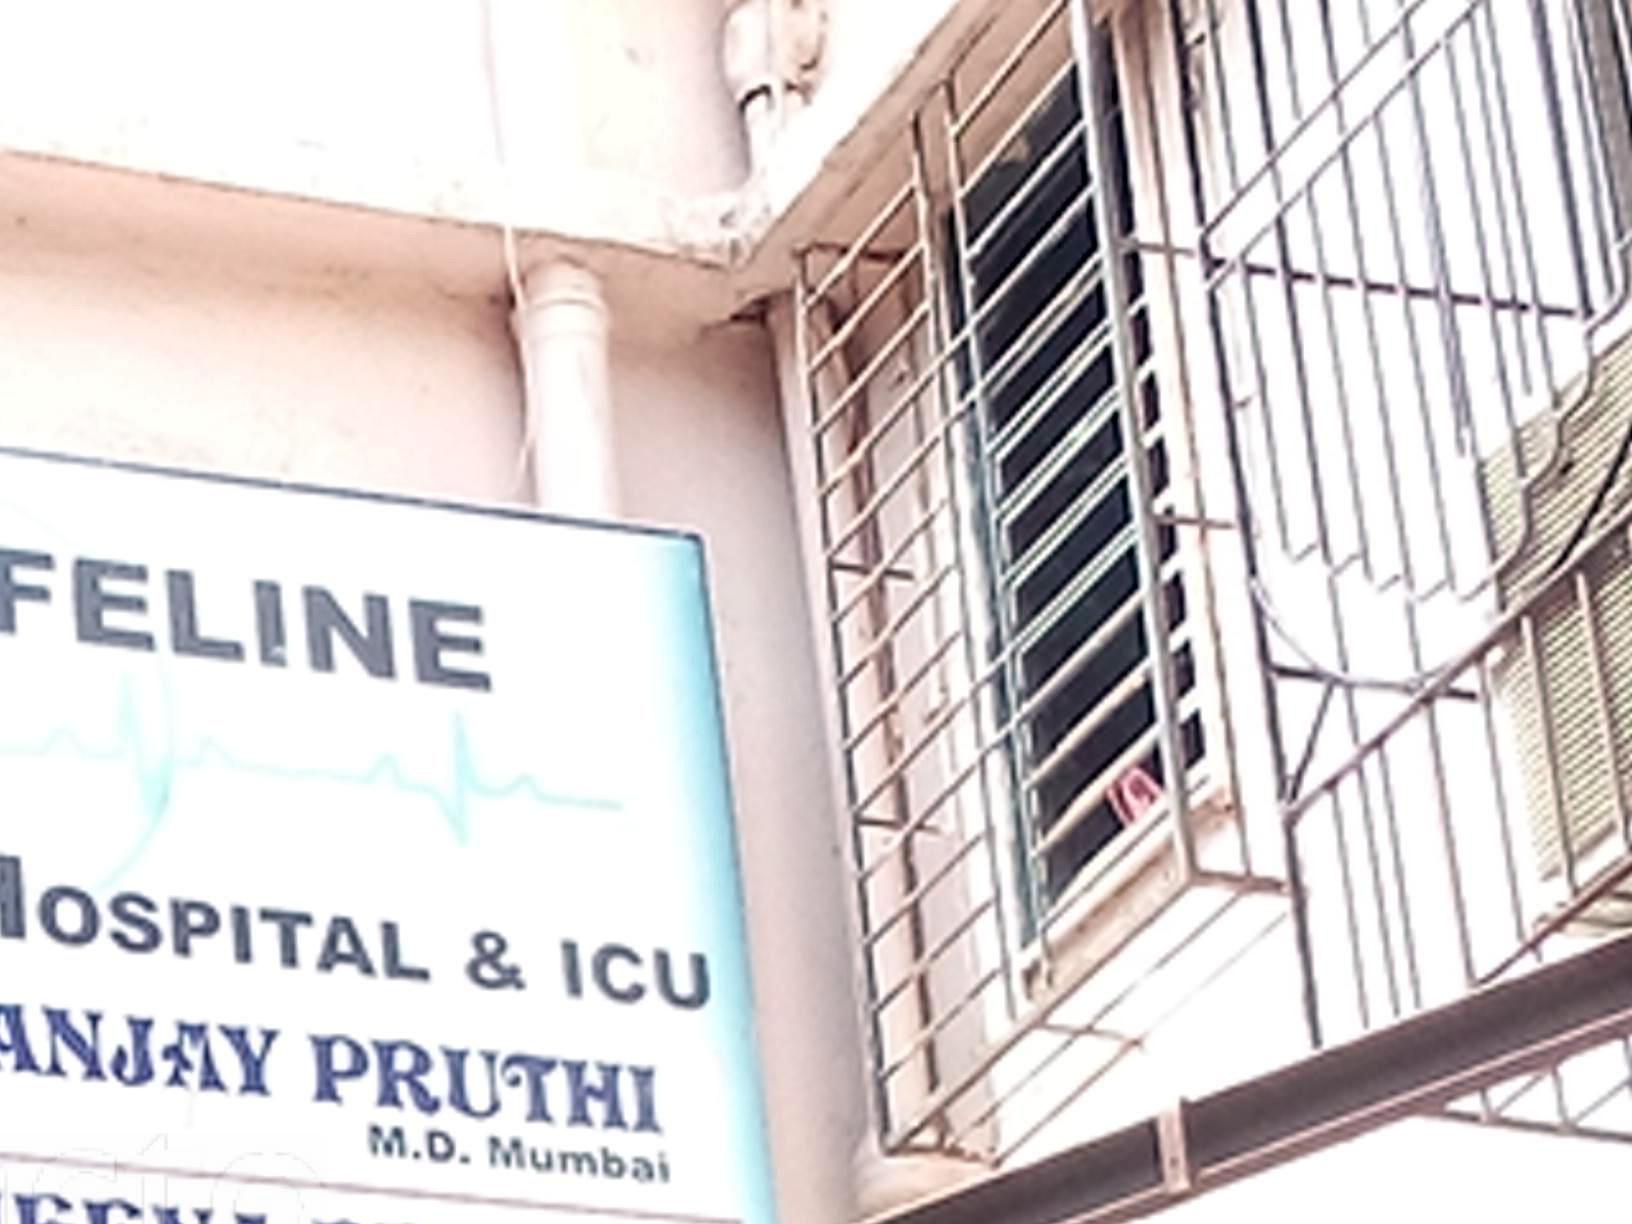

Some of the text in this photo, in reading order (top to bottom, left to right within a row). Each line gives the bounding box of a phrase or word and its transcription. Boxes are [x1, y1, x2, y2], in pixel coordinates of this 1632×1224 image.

[466, 929, 526, 991] &
[562, 940, 713, 1010] ICU
[308, 1034, 663, 1134] PRUTHI
[368, 1125, 670, 1183] M.D. Mumbai
